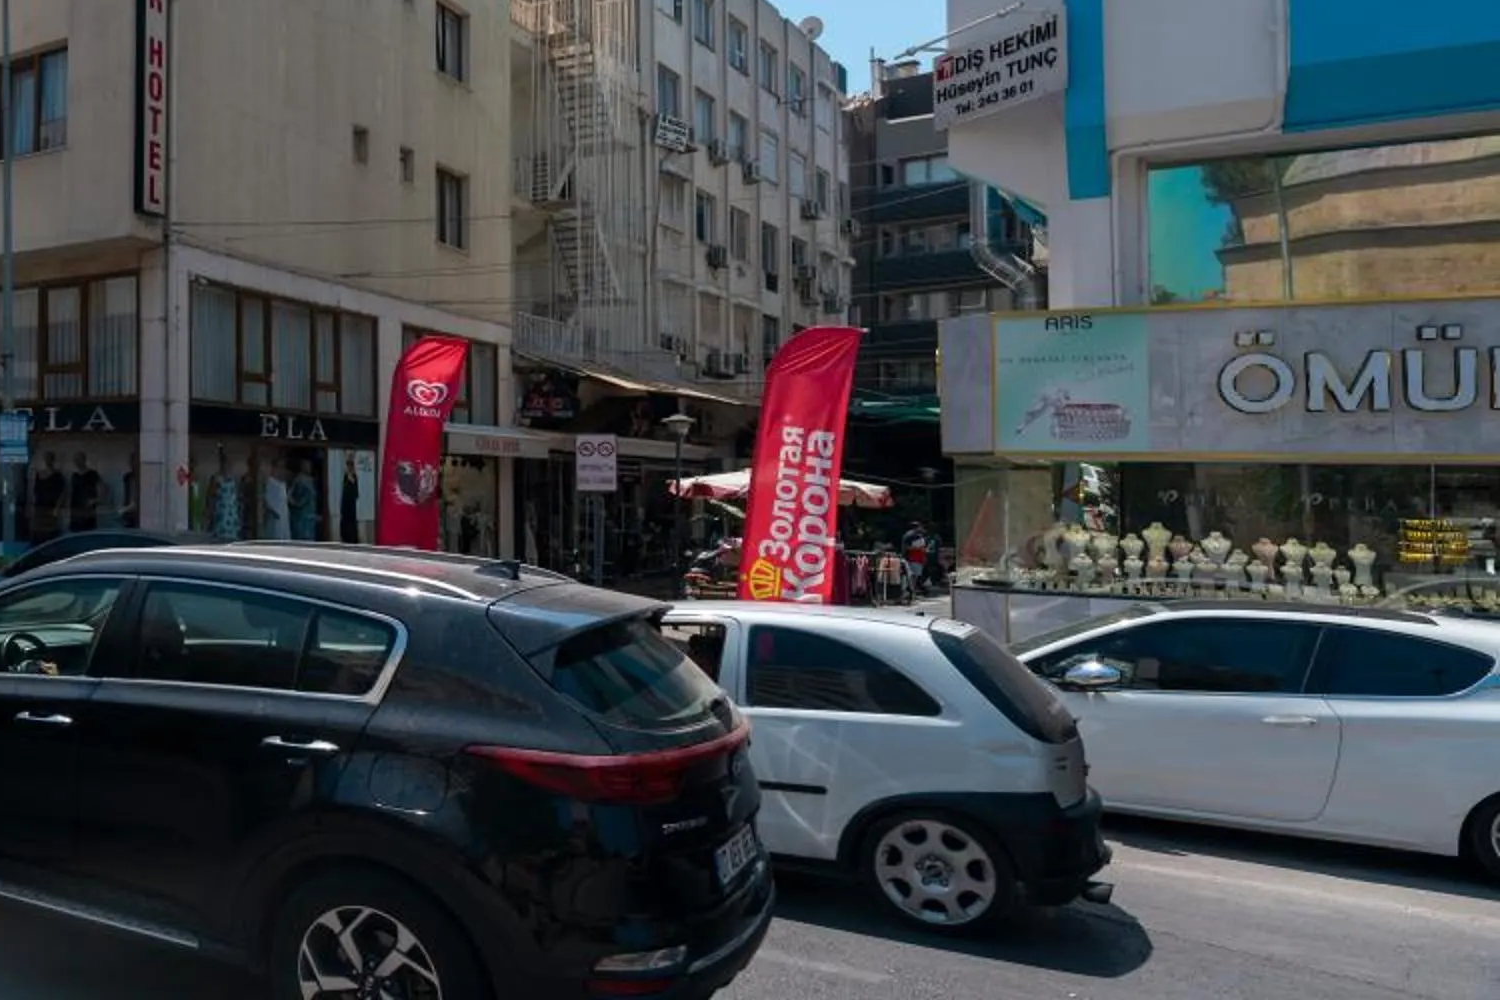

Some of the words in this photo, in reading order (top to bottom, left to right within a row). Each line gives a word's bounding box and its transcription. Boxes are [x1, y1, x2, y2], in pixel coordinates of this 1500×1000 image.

[937, 71, 1001, 104] Hüseyin
[1006, 47, 1057, 79] TUNÇ
[955, 49, 984, 75] DİŞ
[990, 14, 1057, 62] HEKİMİ
[148, 34, 163, 205] HOTEL
[260, 413, 328, 440] ELA
[758, 426, 804, 562] Золотая
[781, 430, 836, 605] Корона
